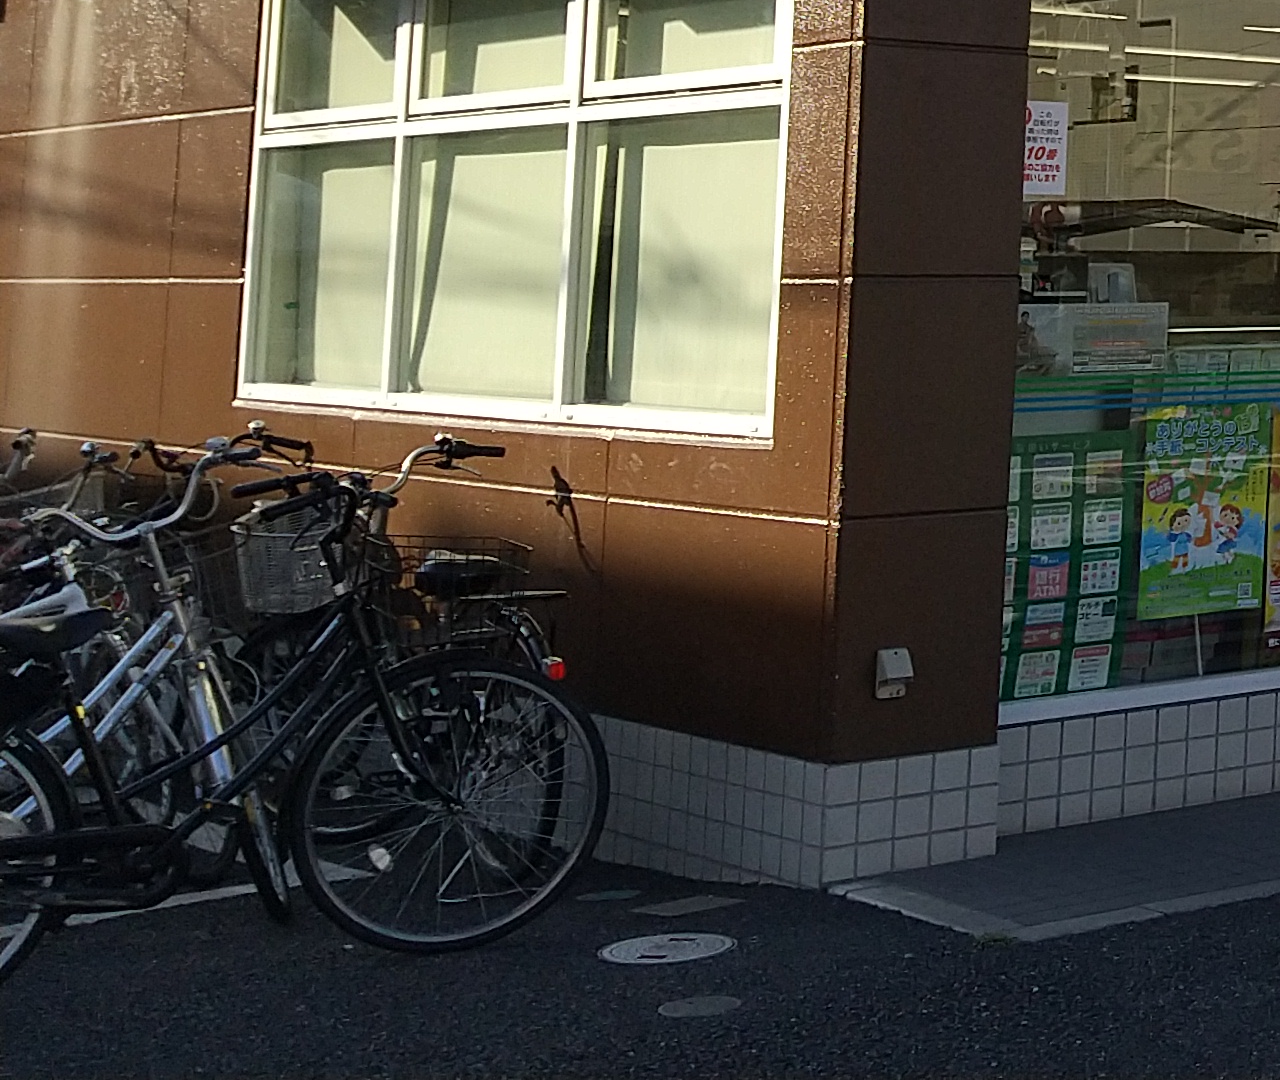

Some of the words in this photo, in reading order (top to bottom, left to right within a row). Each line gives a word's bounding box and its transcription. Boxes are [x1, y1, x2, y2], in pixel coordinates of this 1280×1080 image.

[1025, 145, 1058, 161] 10番
[1155, 419, 1237, 439] ありがとうの
[1034, 584, 1061, 597] ATM
